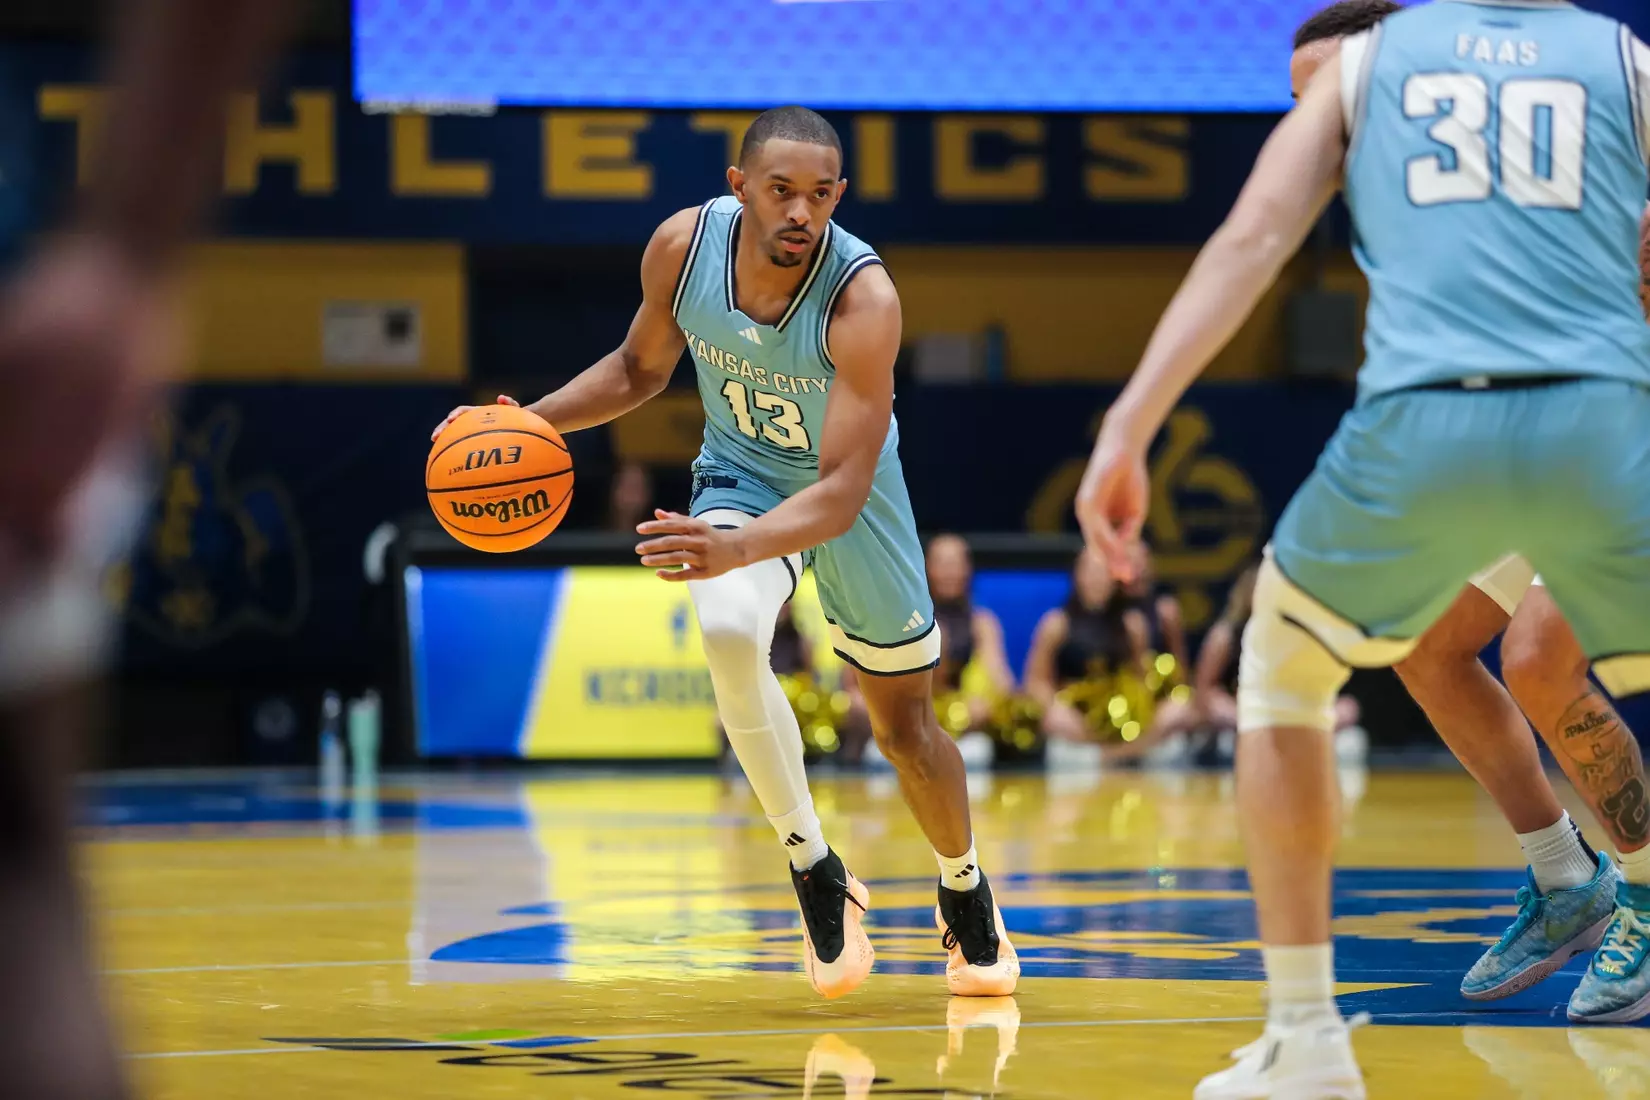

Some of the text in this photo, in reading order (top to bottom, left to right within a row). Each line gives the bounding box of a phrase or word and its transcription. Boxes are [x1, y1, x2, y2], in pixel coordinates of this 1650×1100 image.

[1455, 32, 1540, 67] FAAS
[1402, 71, 1589, 213] 30
[684, 328, 829, 395] KANSAS CITY
[720, 378, 812, 451] 13
[464, 445, 523, 471] EVO
[449, 489, 552, 523] Wilson
